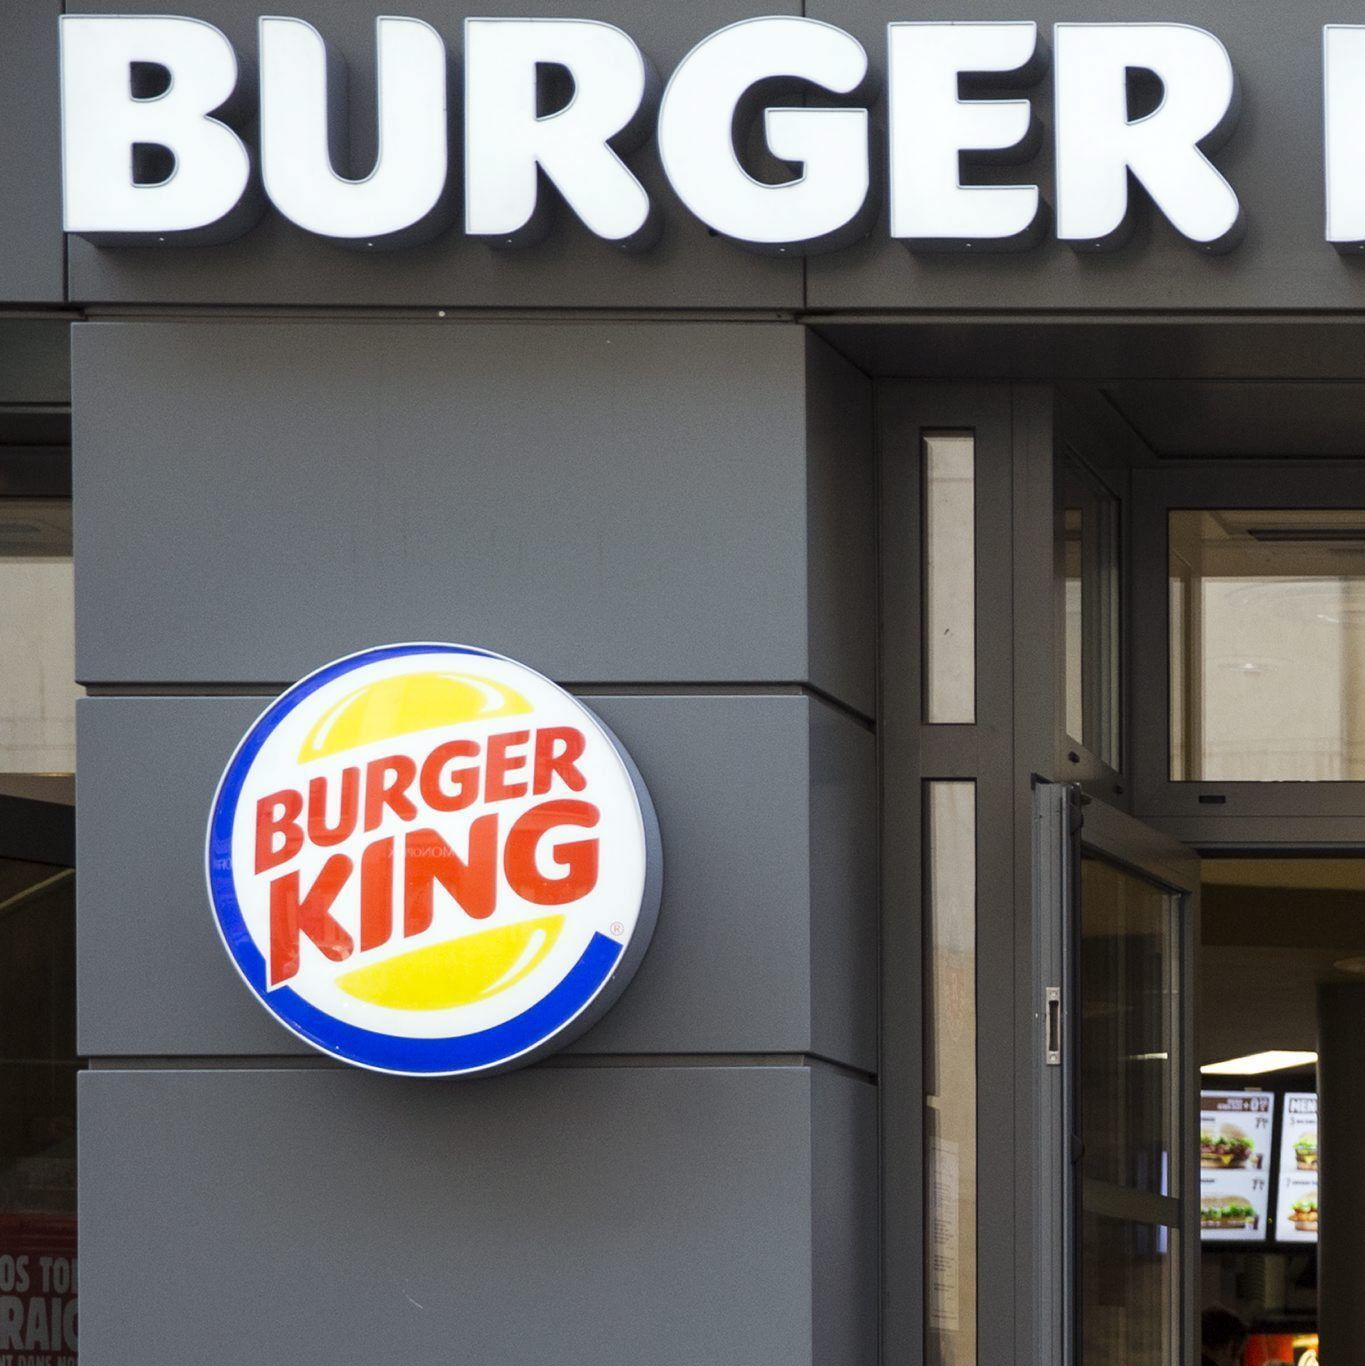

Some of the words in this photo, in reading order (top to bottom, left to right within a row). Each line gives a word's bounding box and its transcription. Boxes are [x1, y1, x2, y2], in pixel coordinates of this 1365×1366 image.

[61, 14, 1241, 246] BURGER
[254, 726, 588, 876] BURGER
[269, 799, 601, 987] KING
